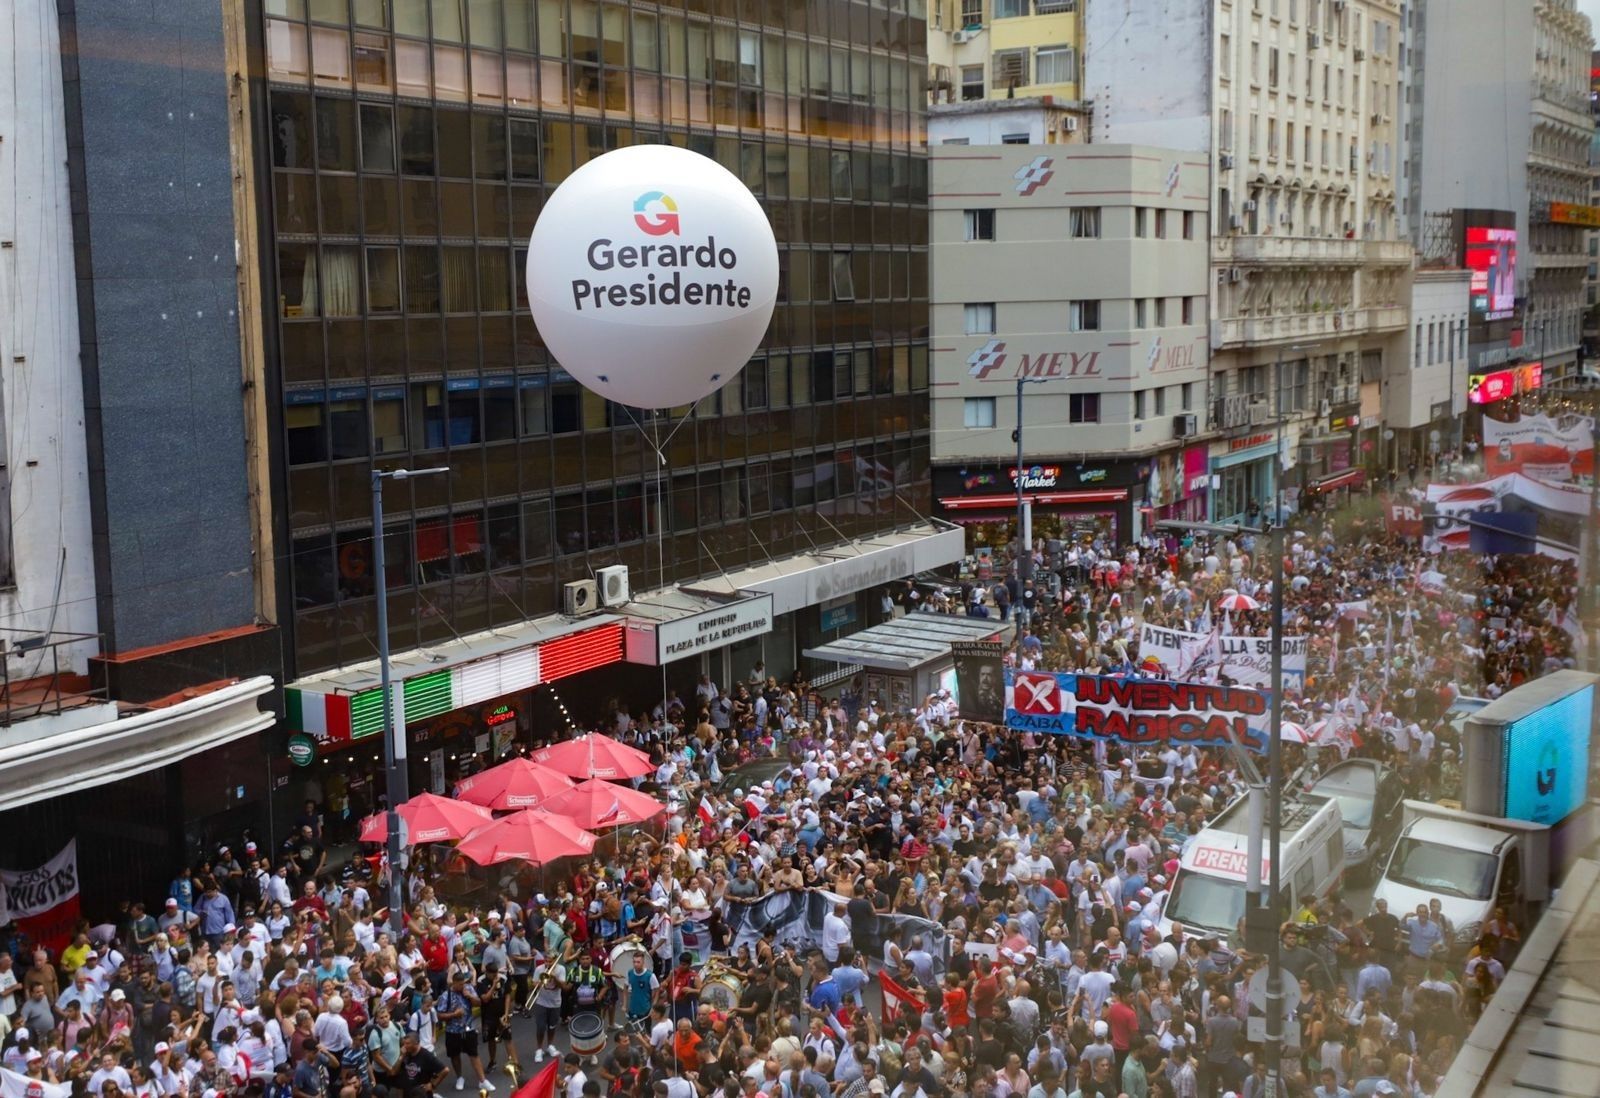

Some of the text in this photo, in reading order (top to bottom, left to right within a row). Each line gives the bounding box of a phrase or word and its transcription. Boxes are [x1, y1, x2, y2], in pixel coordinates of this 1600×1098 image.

[587, 236, 737, 271] Gerardo
[572, 272, 751, 311] Presidente
[1014, 352, 1102, 377] MEYL
[1165, 343, 1194, 366] MEYL
[1013, 475, 1056, 490] Market
[698, 613, 737, 632] EDIFICIO
[665, 639, 693, 654] PLAZA
[695, 635, 708, 647] DE
[709, 632, 720, 642] LA
[952, 642, 1000, 650] DEMOCRACIA
[1221, 639, 1248, 655] LLA
[1256, 639, 1306, 656] SODATI
[1075, 676, 1267, 716] JUVENTUD
[1009, 715, 1064, 731] CABA
[1075, 706, 1264, 755] RADICAL
